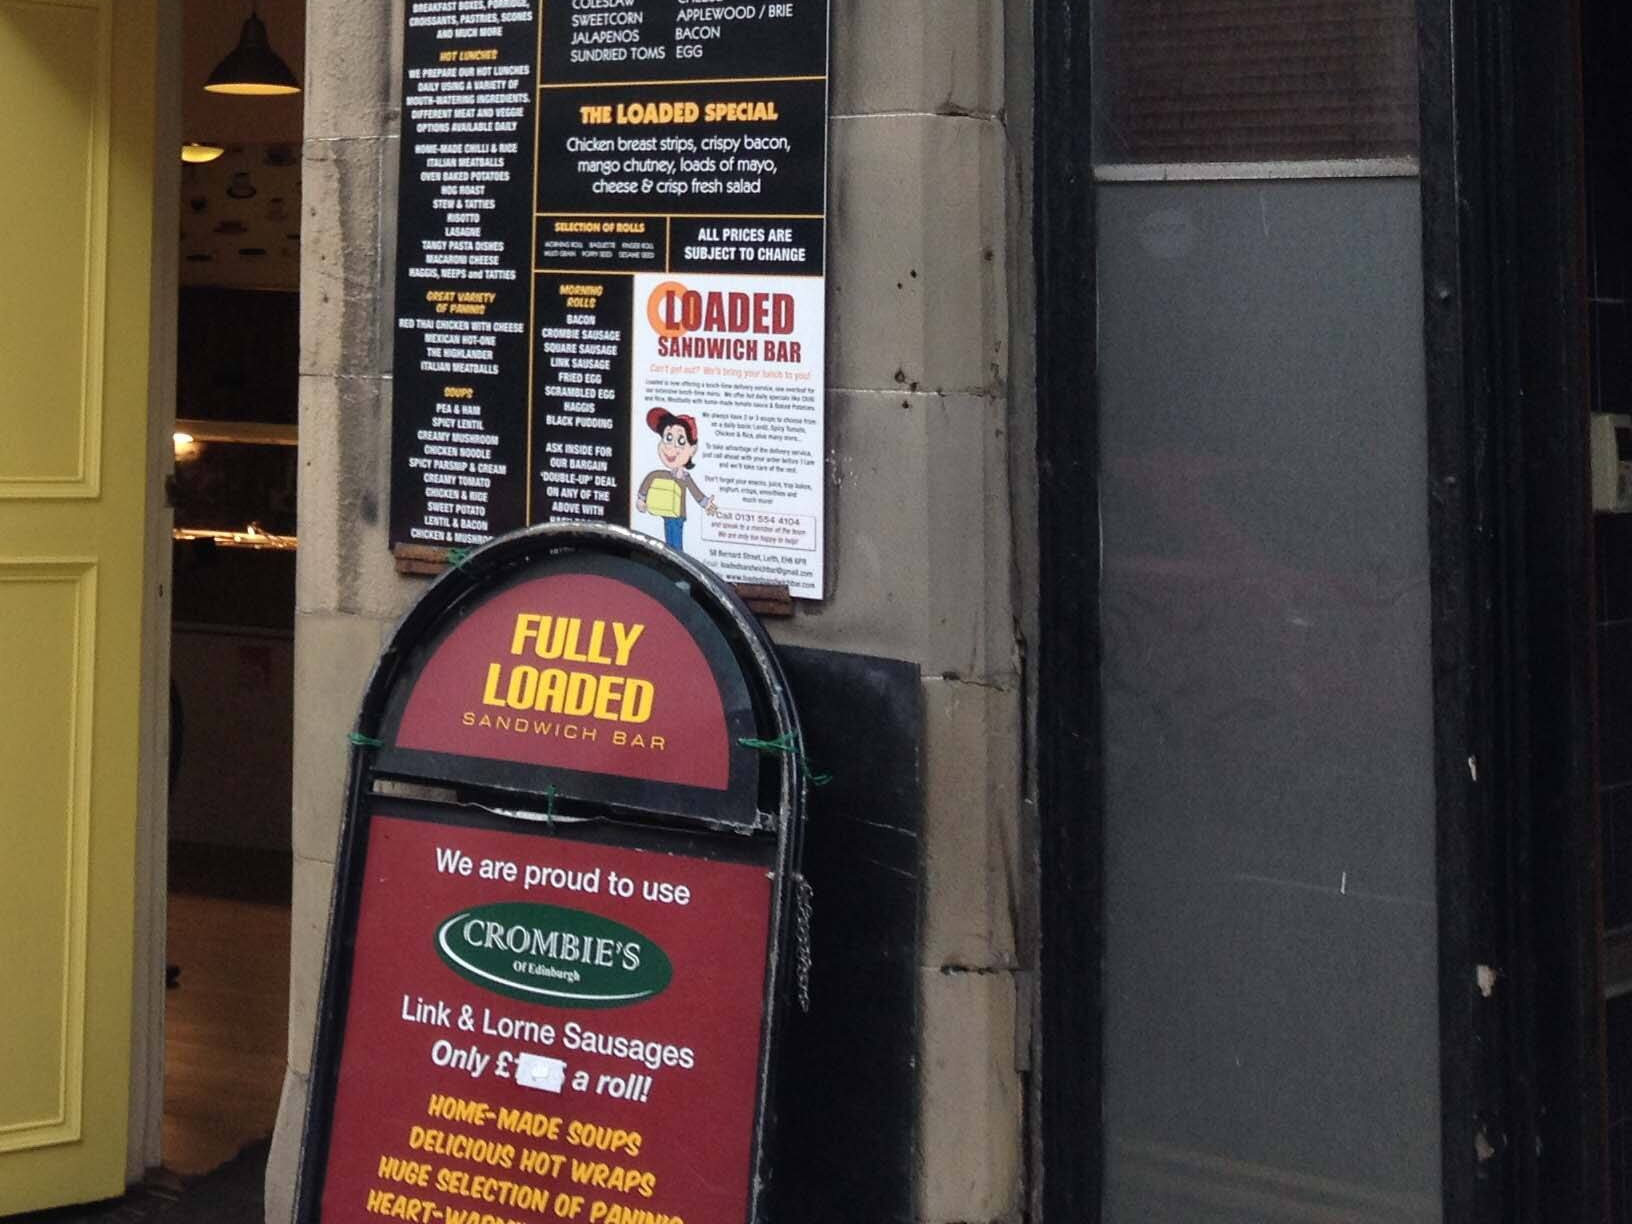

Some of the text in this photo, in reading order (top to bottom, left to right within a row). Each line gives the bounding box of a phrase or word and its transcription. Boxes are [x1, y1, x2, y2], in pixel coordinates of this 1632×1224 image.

[571, 12, 643, 27] SWEETCORN
[677, 6, 755, 22] APPLEWOOD
[768, 4, 793, 18] BRIE
[571, 27, 721, 45] JALAPENOS BACON
[570, 46, 703, 62] SUNDRIED TOMS EGG
[580, 102, 778, 125] THE LOADED SPECIAL
[567, 135, 790, 153] Chicken breast strips, crispy bacon,
[578, 157, 777, 175] mango chutney, loads of mayo,
[592, 179, 761, 195] cheese & crisp fresh salad
[698, 228, 792, 242] ALL PRICES ARE
[684, 246, 806, 262] SUBJECT TO CHANGE
[666, 290, 795, 335] LOADED
[658, 336, 801, 363] SANDWICH BAR
[511, 613, 645, 666] FULLY
[483, 662, 654, 724] LOADED
[462, 712, 665, 751] SANDWICH BAR
[436, 847, 690, 905] We are proud to use
[463, 919, 640, 971] CROMBIE'S
[513, 960, 581, 982] Of Edinburgh
[402, 994, 695, 1069] Link & Lorne Sausages
[431, 1039, 490, 1077] Only
[572, 1070, 589, 1092] a
[596, 1074, 652, 1103] roll!
[428, 1094, 643, 1157] HOME-MADE SOUPS
[409, 1126, 657, 1198] DELICIOUS HOT WRAPS
[378, 1156, 432, 1187] HUGE
[435, 1168, 549, 1213] SELECTION
[553, 1193, 585, 1219] OF
